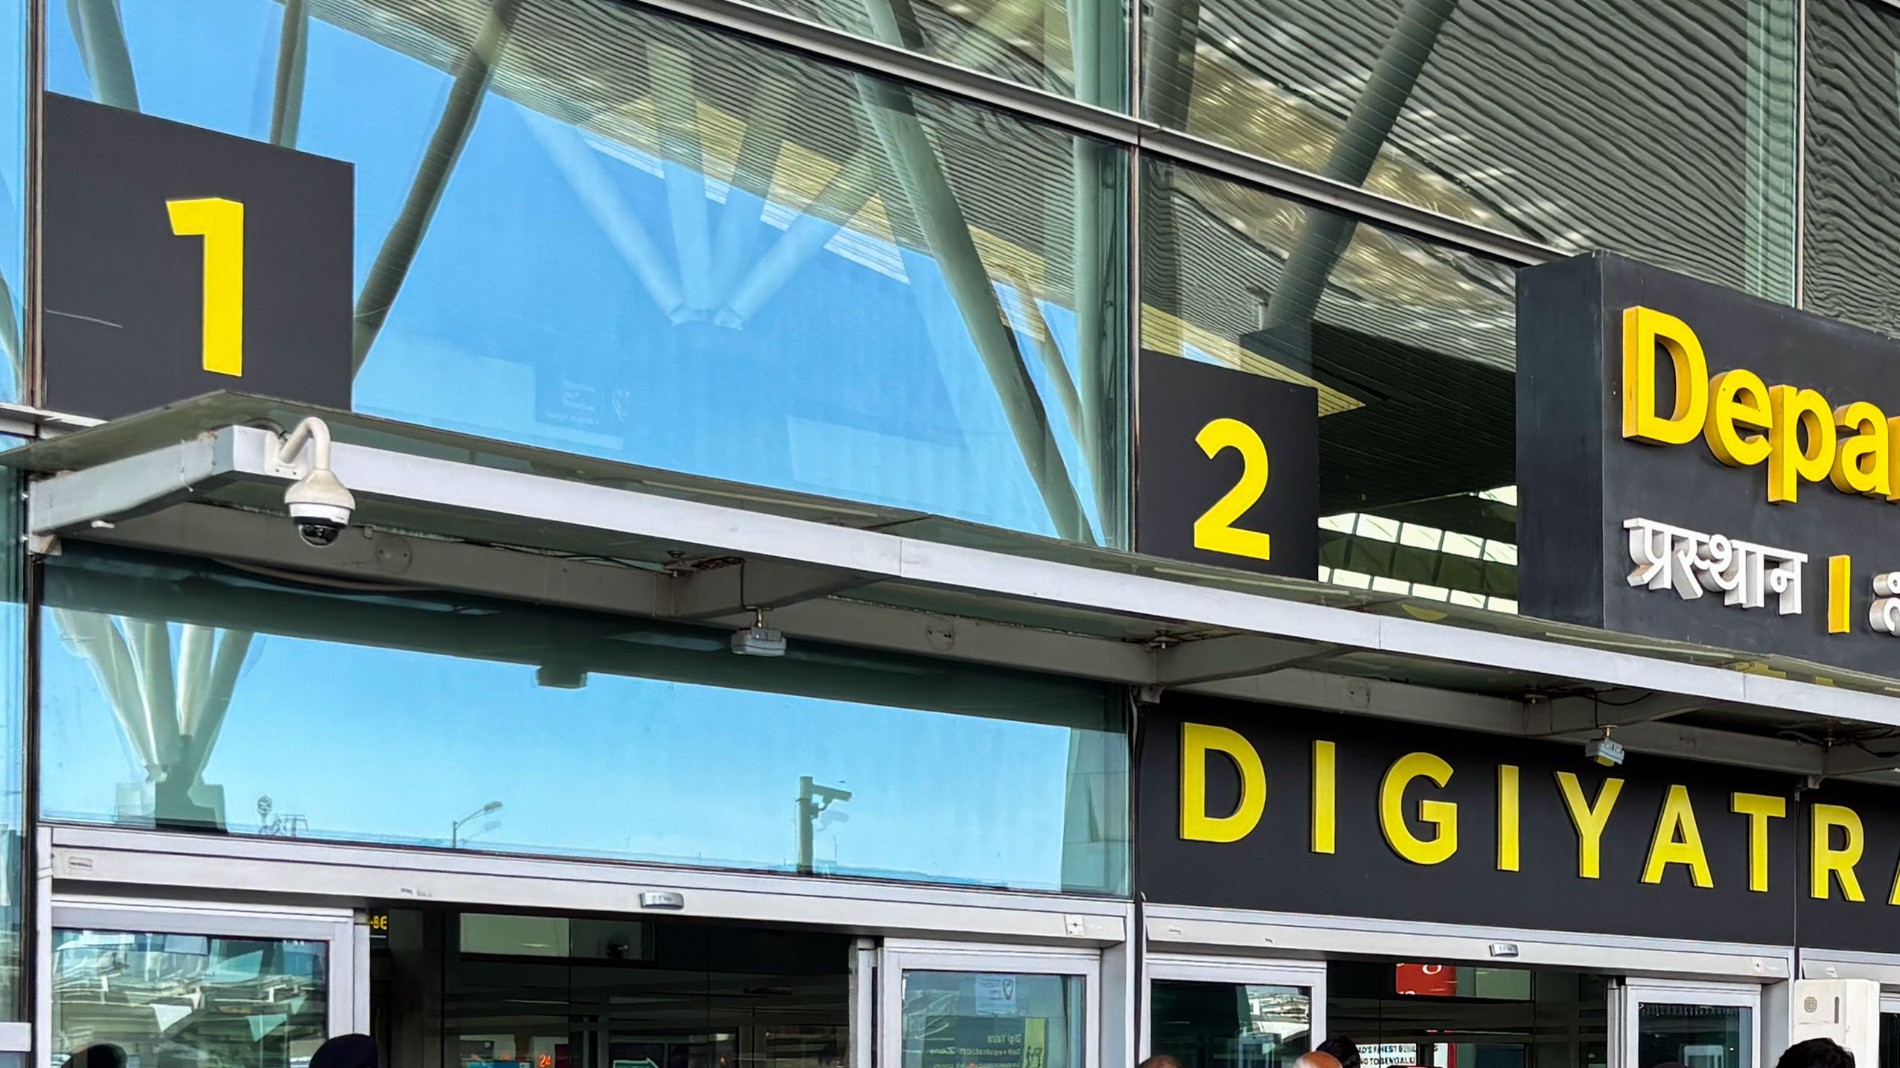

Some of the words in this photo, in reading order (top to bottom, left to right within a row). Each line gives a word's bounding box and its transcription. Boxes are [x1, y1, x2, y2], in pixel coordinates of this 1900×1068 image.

[166, 197, 245, 377] 1
[1193, 418, 1271, 561] 2
[1623, 518, 1809, 615] प्रस्थान
